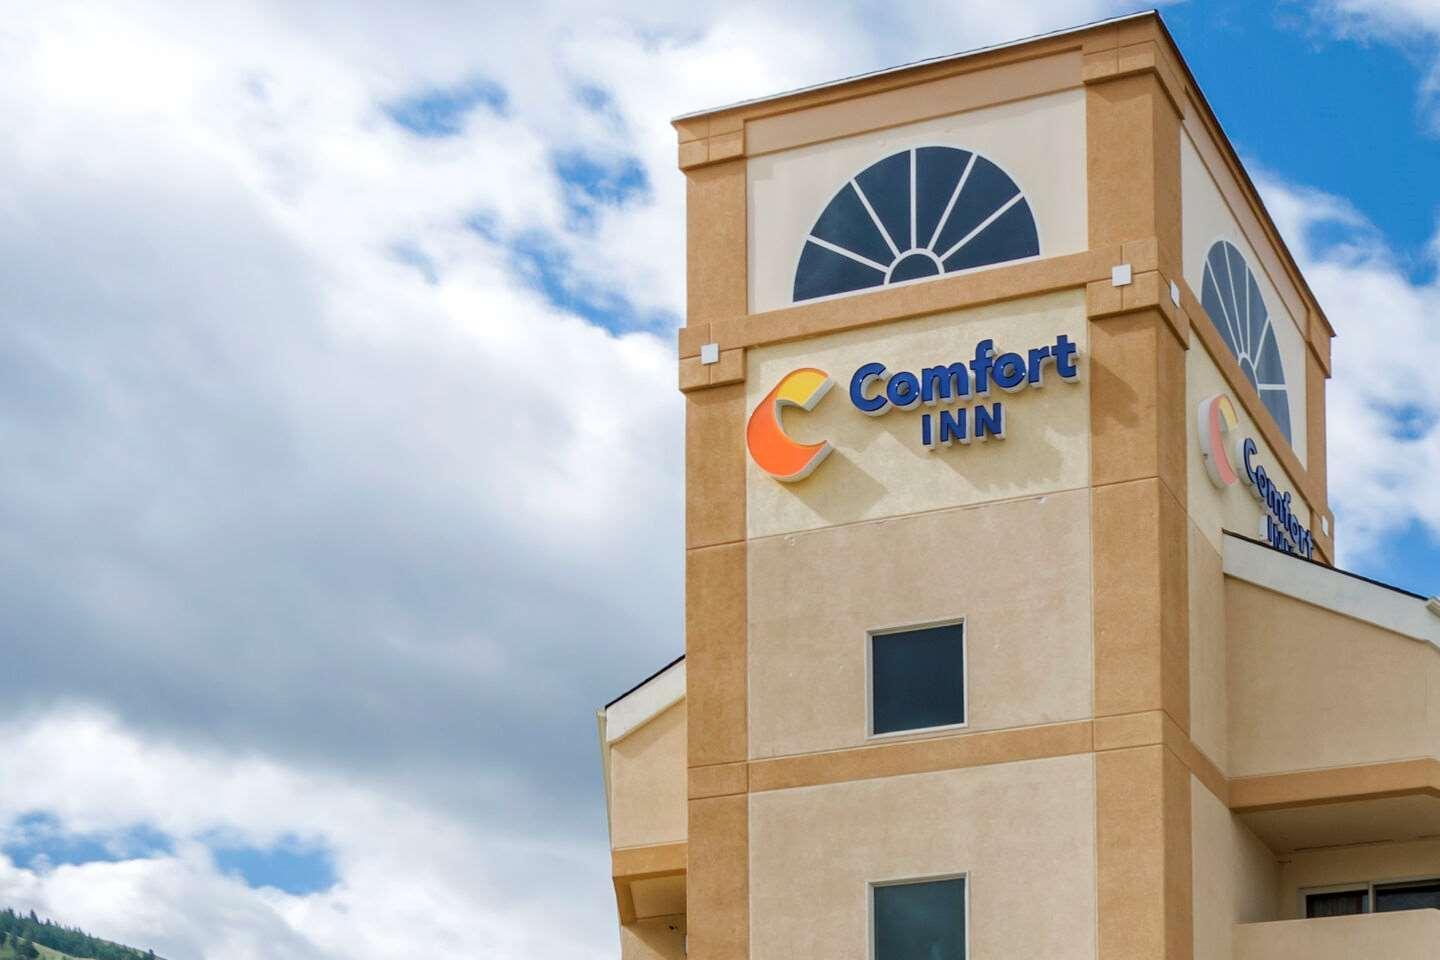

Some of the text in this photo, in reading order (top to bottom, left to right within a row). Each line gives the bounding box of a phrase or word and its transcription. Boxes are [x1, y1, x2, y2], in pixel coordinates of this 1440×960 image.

[850, 335, 1078, 413] Comfort
[921, 403, 1003, 446] INN
[1243, 437, 1313, 560] Comfort
